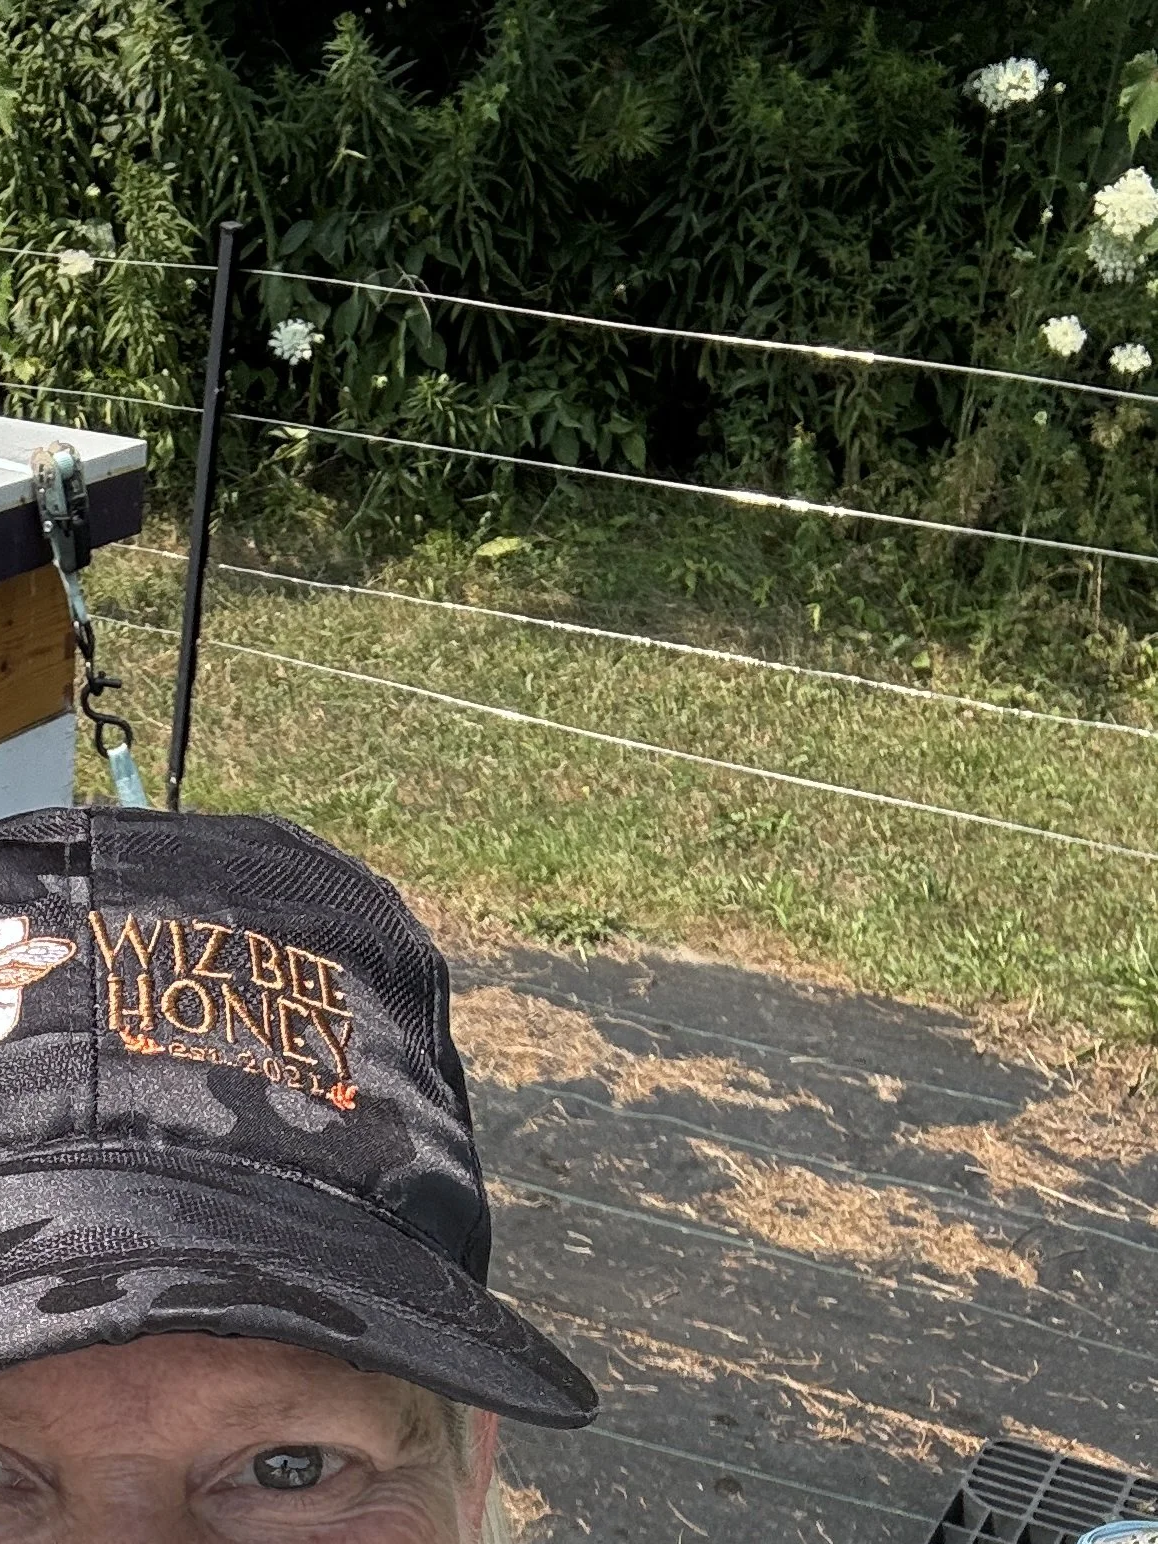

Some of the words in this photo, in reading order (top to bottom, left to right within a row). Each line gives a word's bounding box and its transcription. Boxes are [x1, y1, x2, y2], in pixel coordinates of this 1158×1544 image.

[88, 910, 233, 978] WIZ
[243, 930, 353, 1017] BEE
[107, 973, 353, 1081] HONEY
[238, 1050, 325, 1096] 2021
